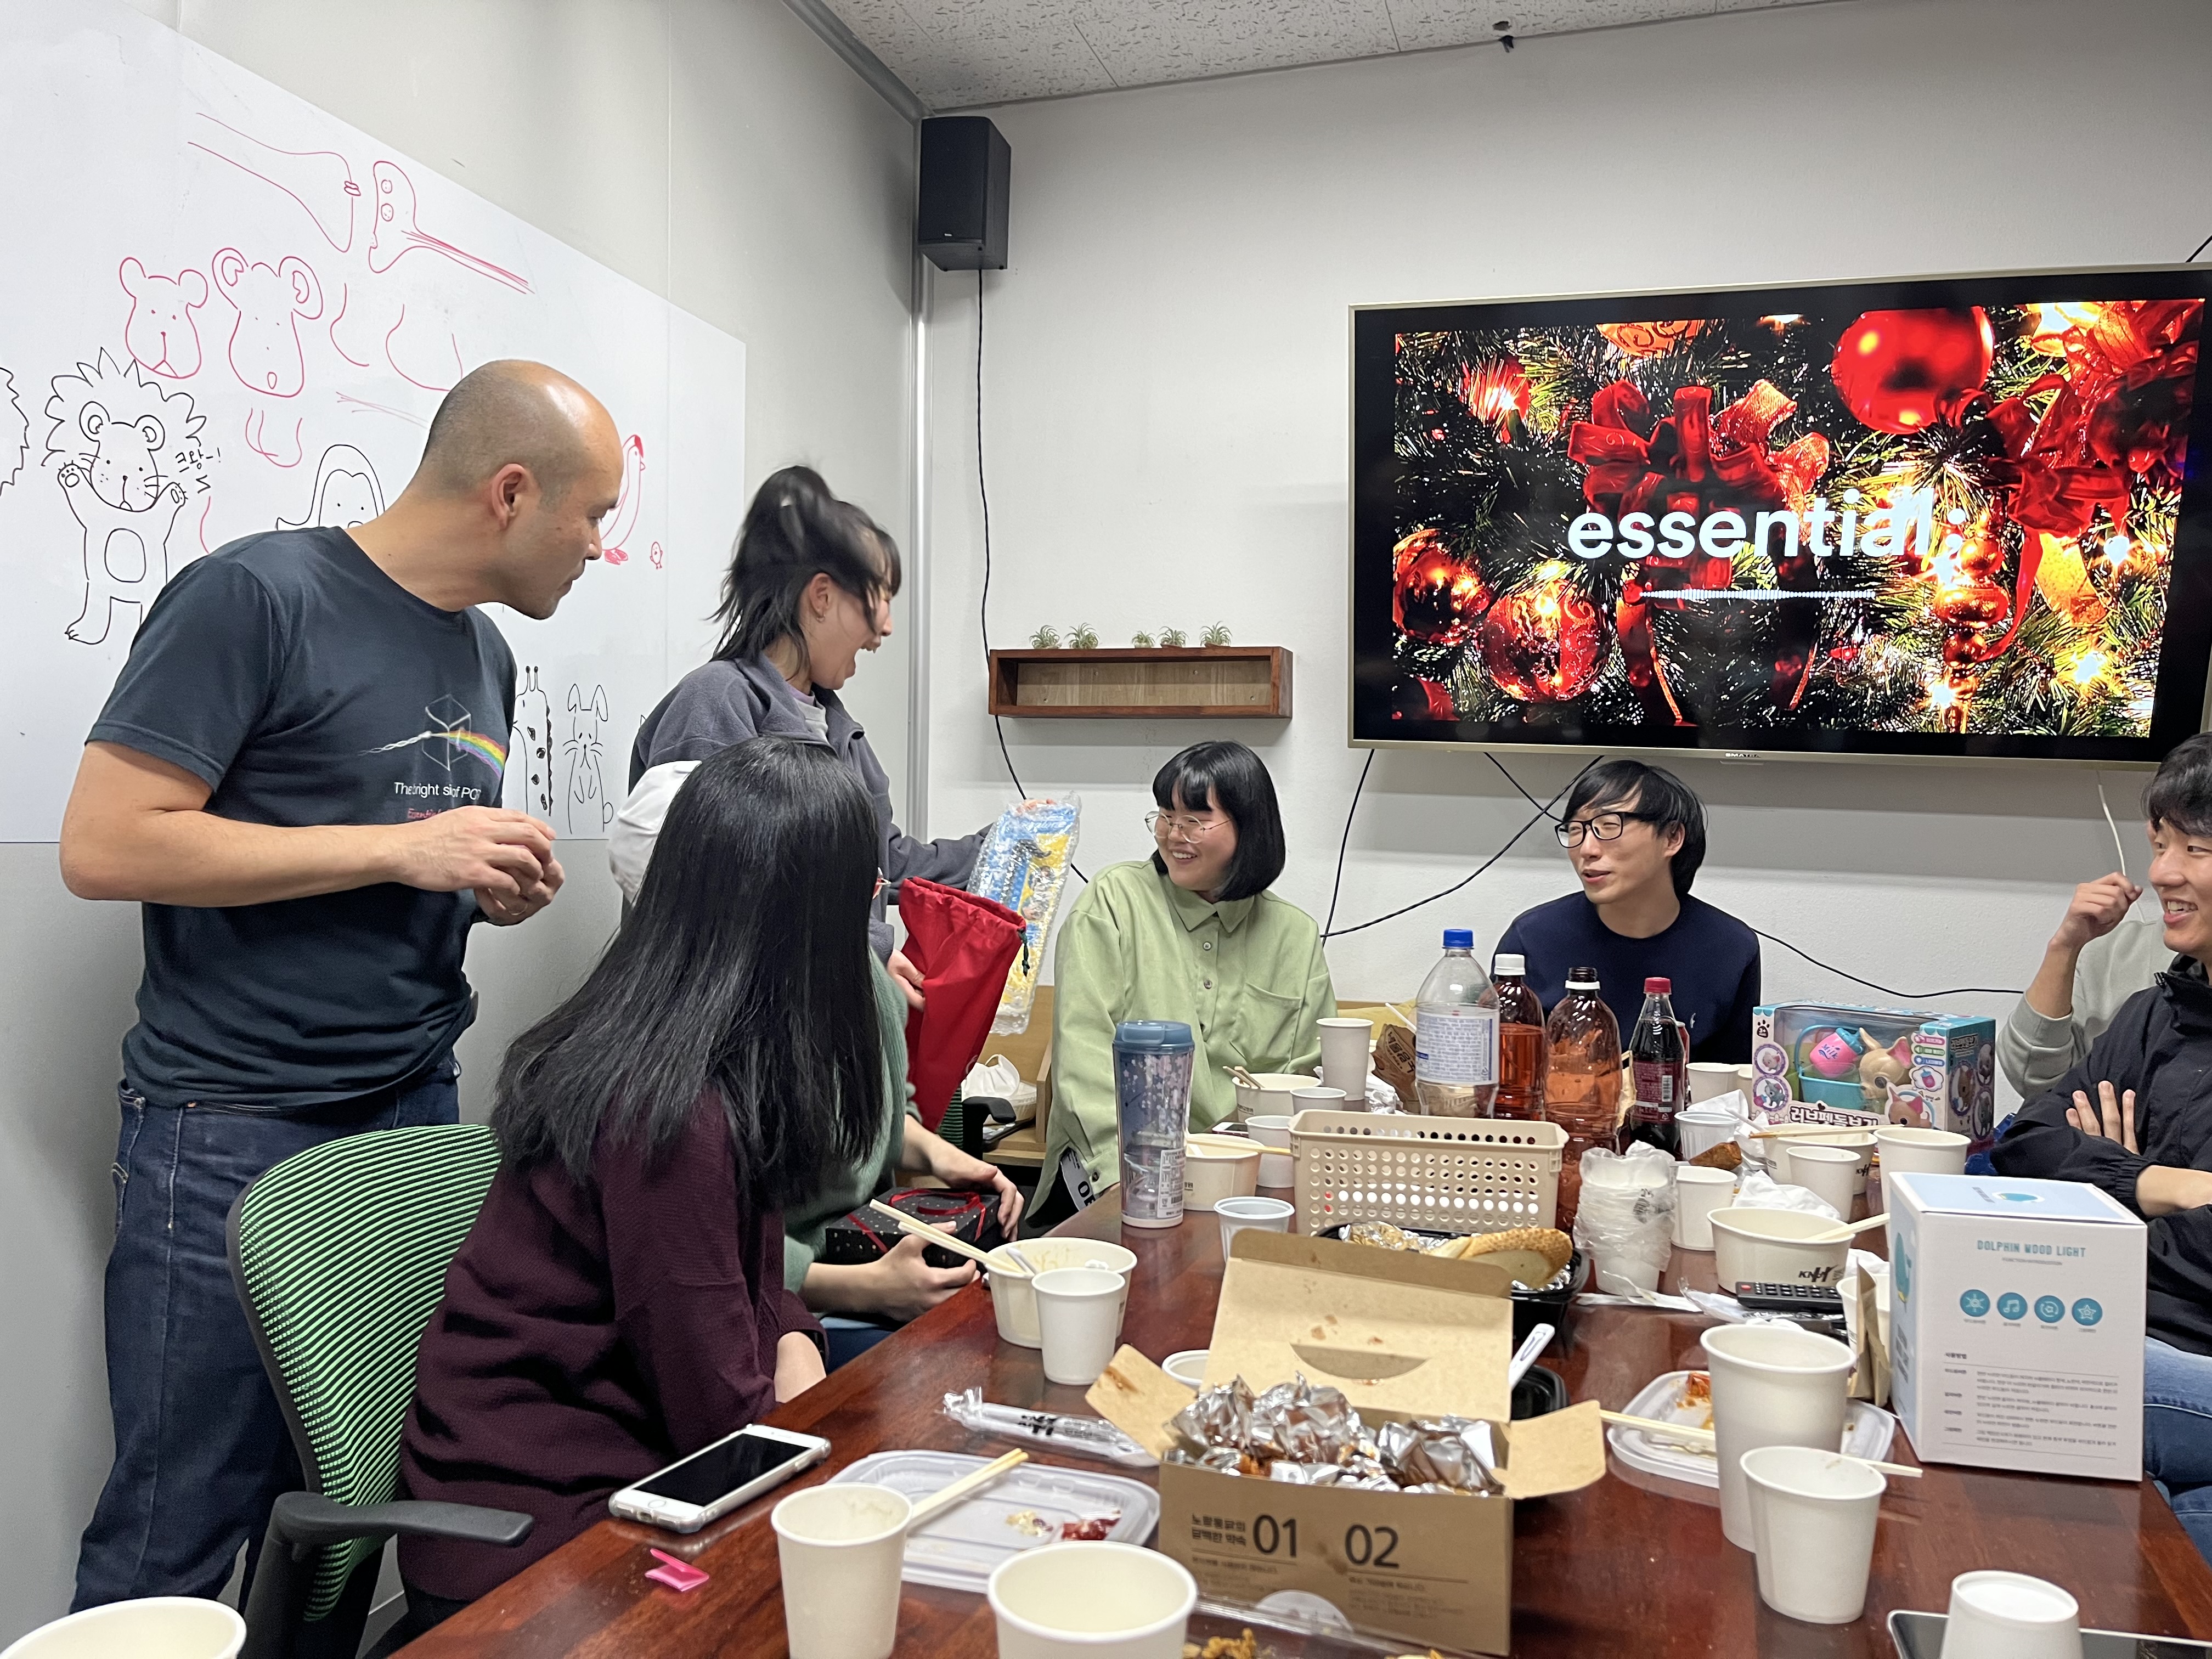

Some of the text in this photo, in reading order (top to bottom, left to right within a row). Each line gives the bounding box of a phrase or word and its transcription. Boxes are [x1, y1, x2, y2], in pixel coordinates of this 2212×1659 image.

[1821, 1043, 1838, 1059] Milk
[1977, 1240, 2020, 1253] DOLPHIN
[2056, 1245, 2086, 1257] LIGHT
[1253, 1514, 1297, 1558] 01
[1345, 1524, 1399, 1568] 02
